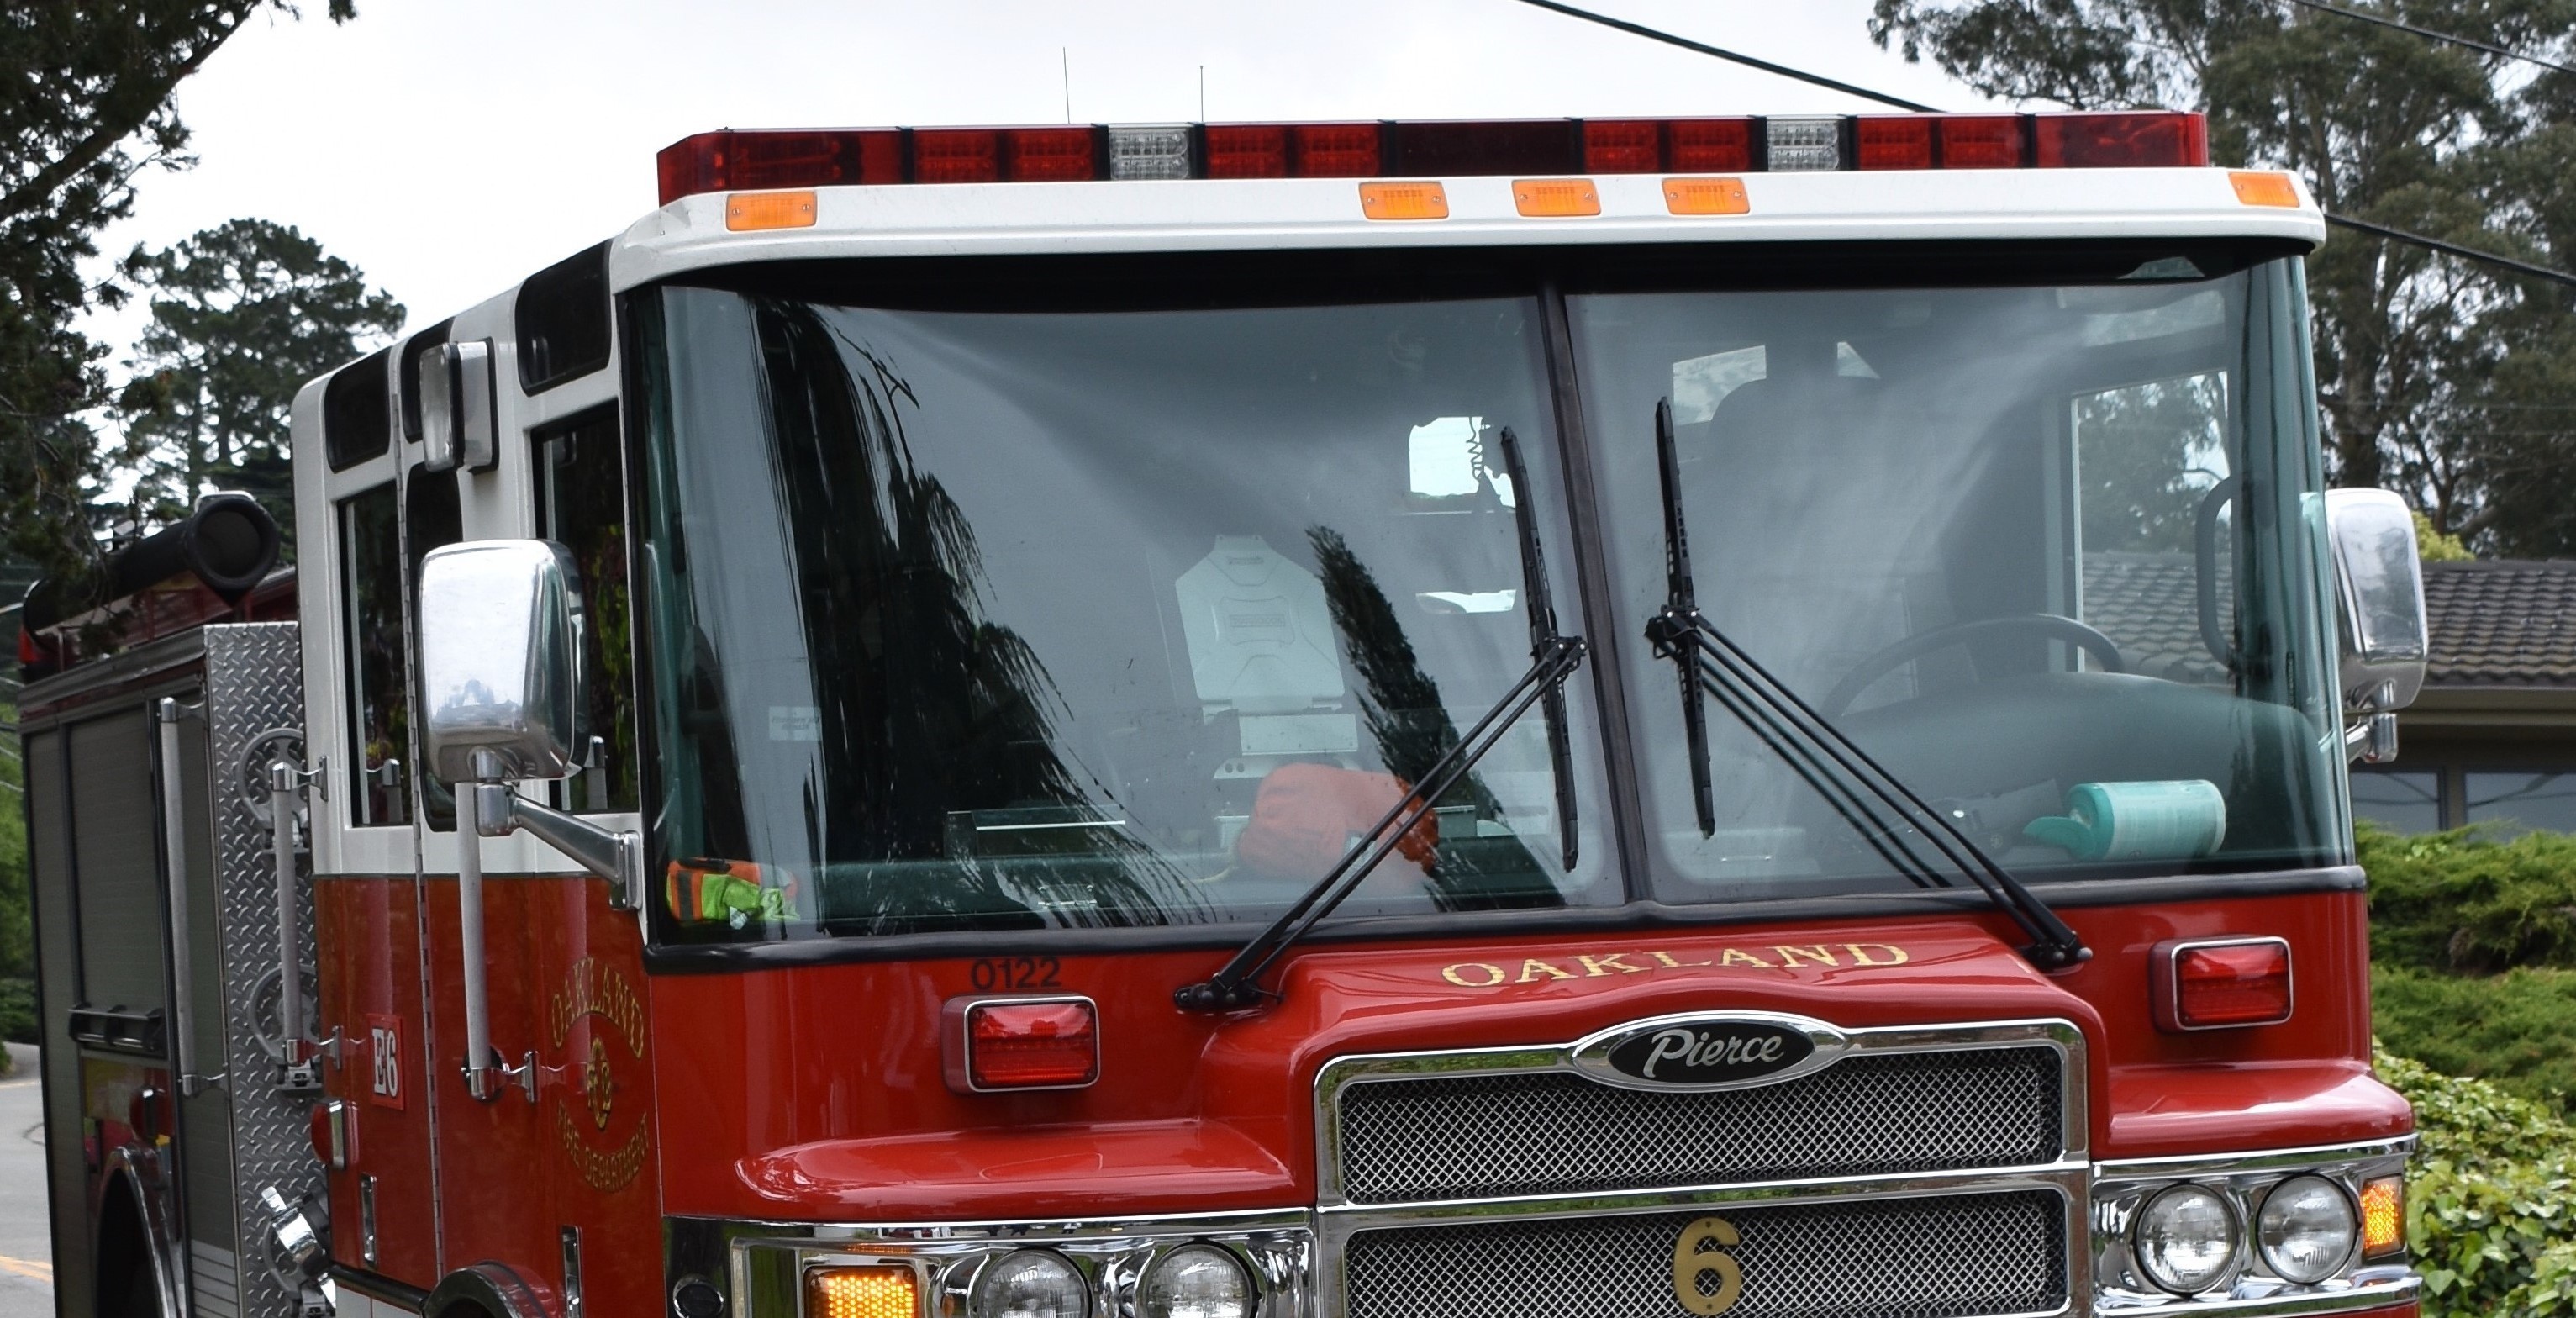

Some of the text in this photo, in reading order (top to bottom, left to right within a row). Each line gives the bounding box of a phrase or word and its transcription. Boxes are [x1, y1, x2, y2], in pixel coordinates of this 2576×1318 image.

[971, 957, 1062, 990] 0122
[1441, 943, 1910, 987] OAKLAND
[552, 957, 645, 1059] OAKLAND
[371, 1027, 398, 1098] E6
[1642, 1029, 1784, 1078] Pierce
[558, 1098, 650, 1194] FIRE DEPARTMENT
[1673, 1215, 1742, 1316] 6
